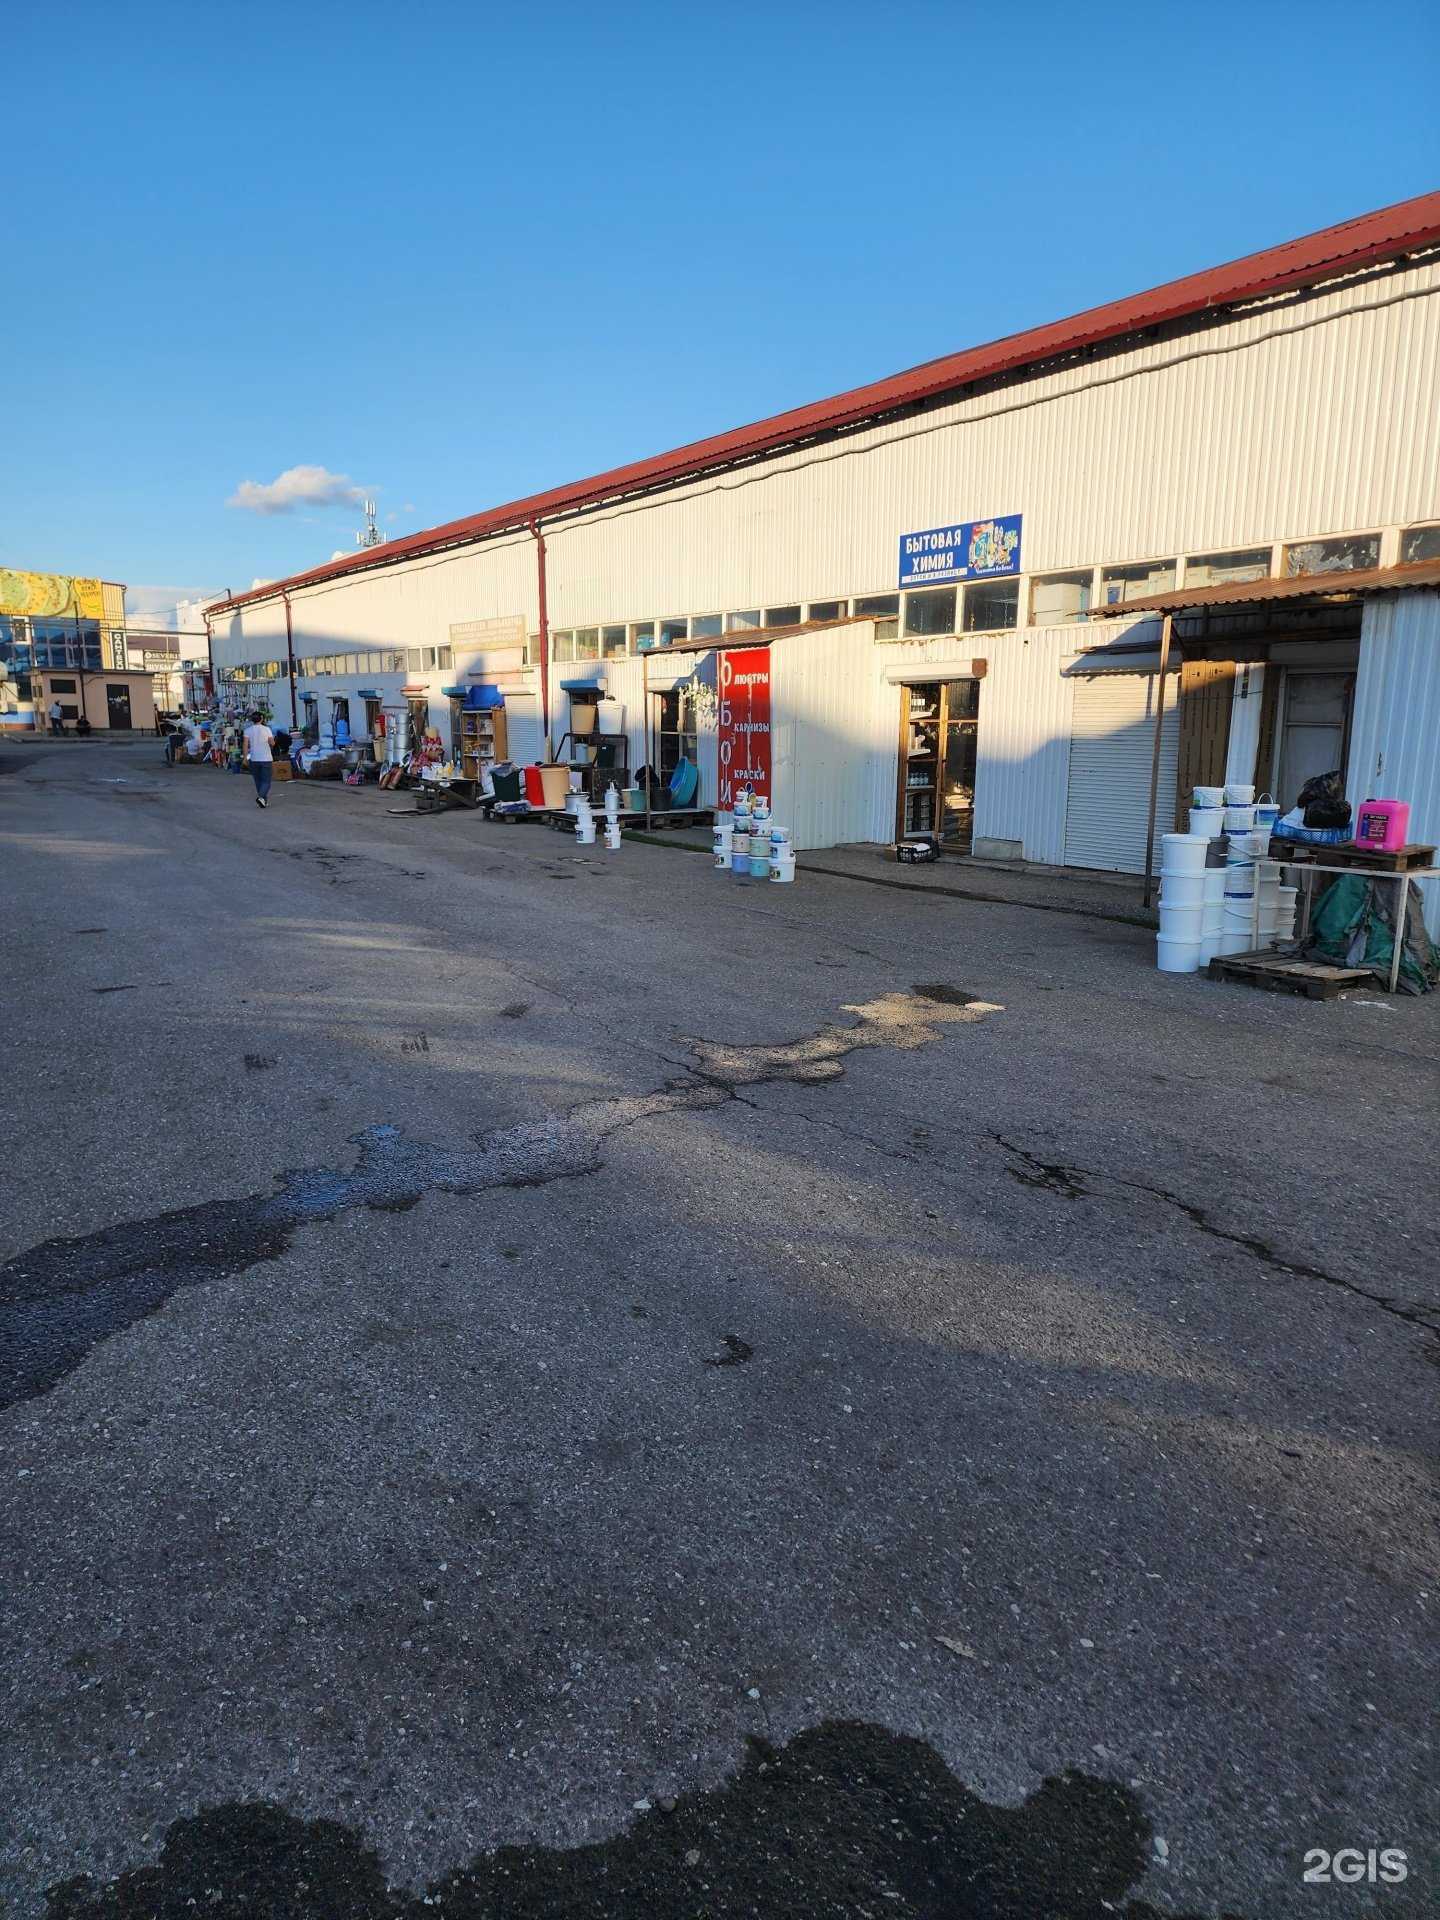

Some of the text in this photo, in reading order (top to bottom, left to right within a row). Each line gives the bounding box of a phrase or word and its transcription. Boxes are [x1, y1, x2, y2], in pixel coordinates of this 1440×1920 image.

[906, 529, 962, 554] БЫТОВАЯ
[912, 552, 954, 574] ХИМИЯ
[734, 673, 769, 685] ЛЮСТРЫ
[734, 722, 770, 733] КАРНИЗЫ
[734, 769, 766, 780] КРАСКИ
